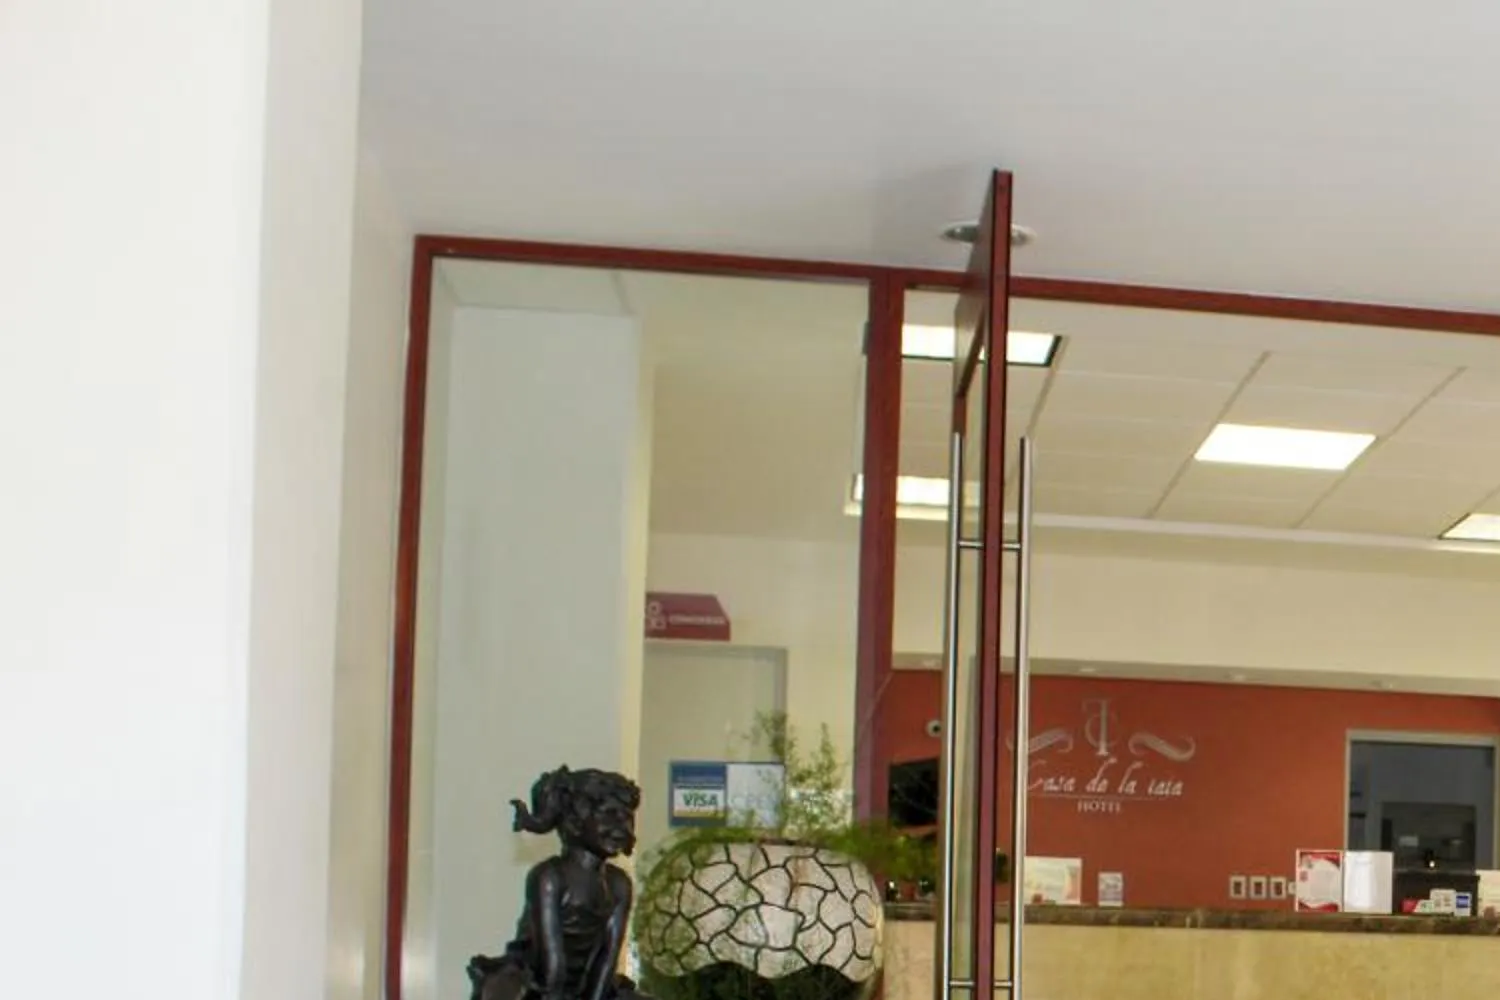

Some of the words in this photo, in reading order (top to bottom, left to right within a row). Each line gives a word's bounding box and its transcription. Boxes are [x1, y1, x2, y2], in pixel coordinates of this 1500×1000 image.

[1086, 757, 1118, 793] de
[1118, 761, 1144, 794] la
[682, 792, 719, 807] VISA
